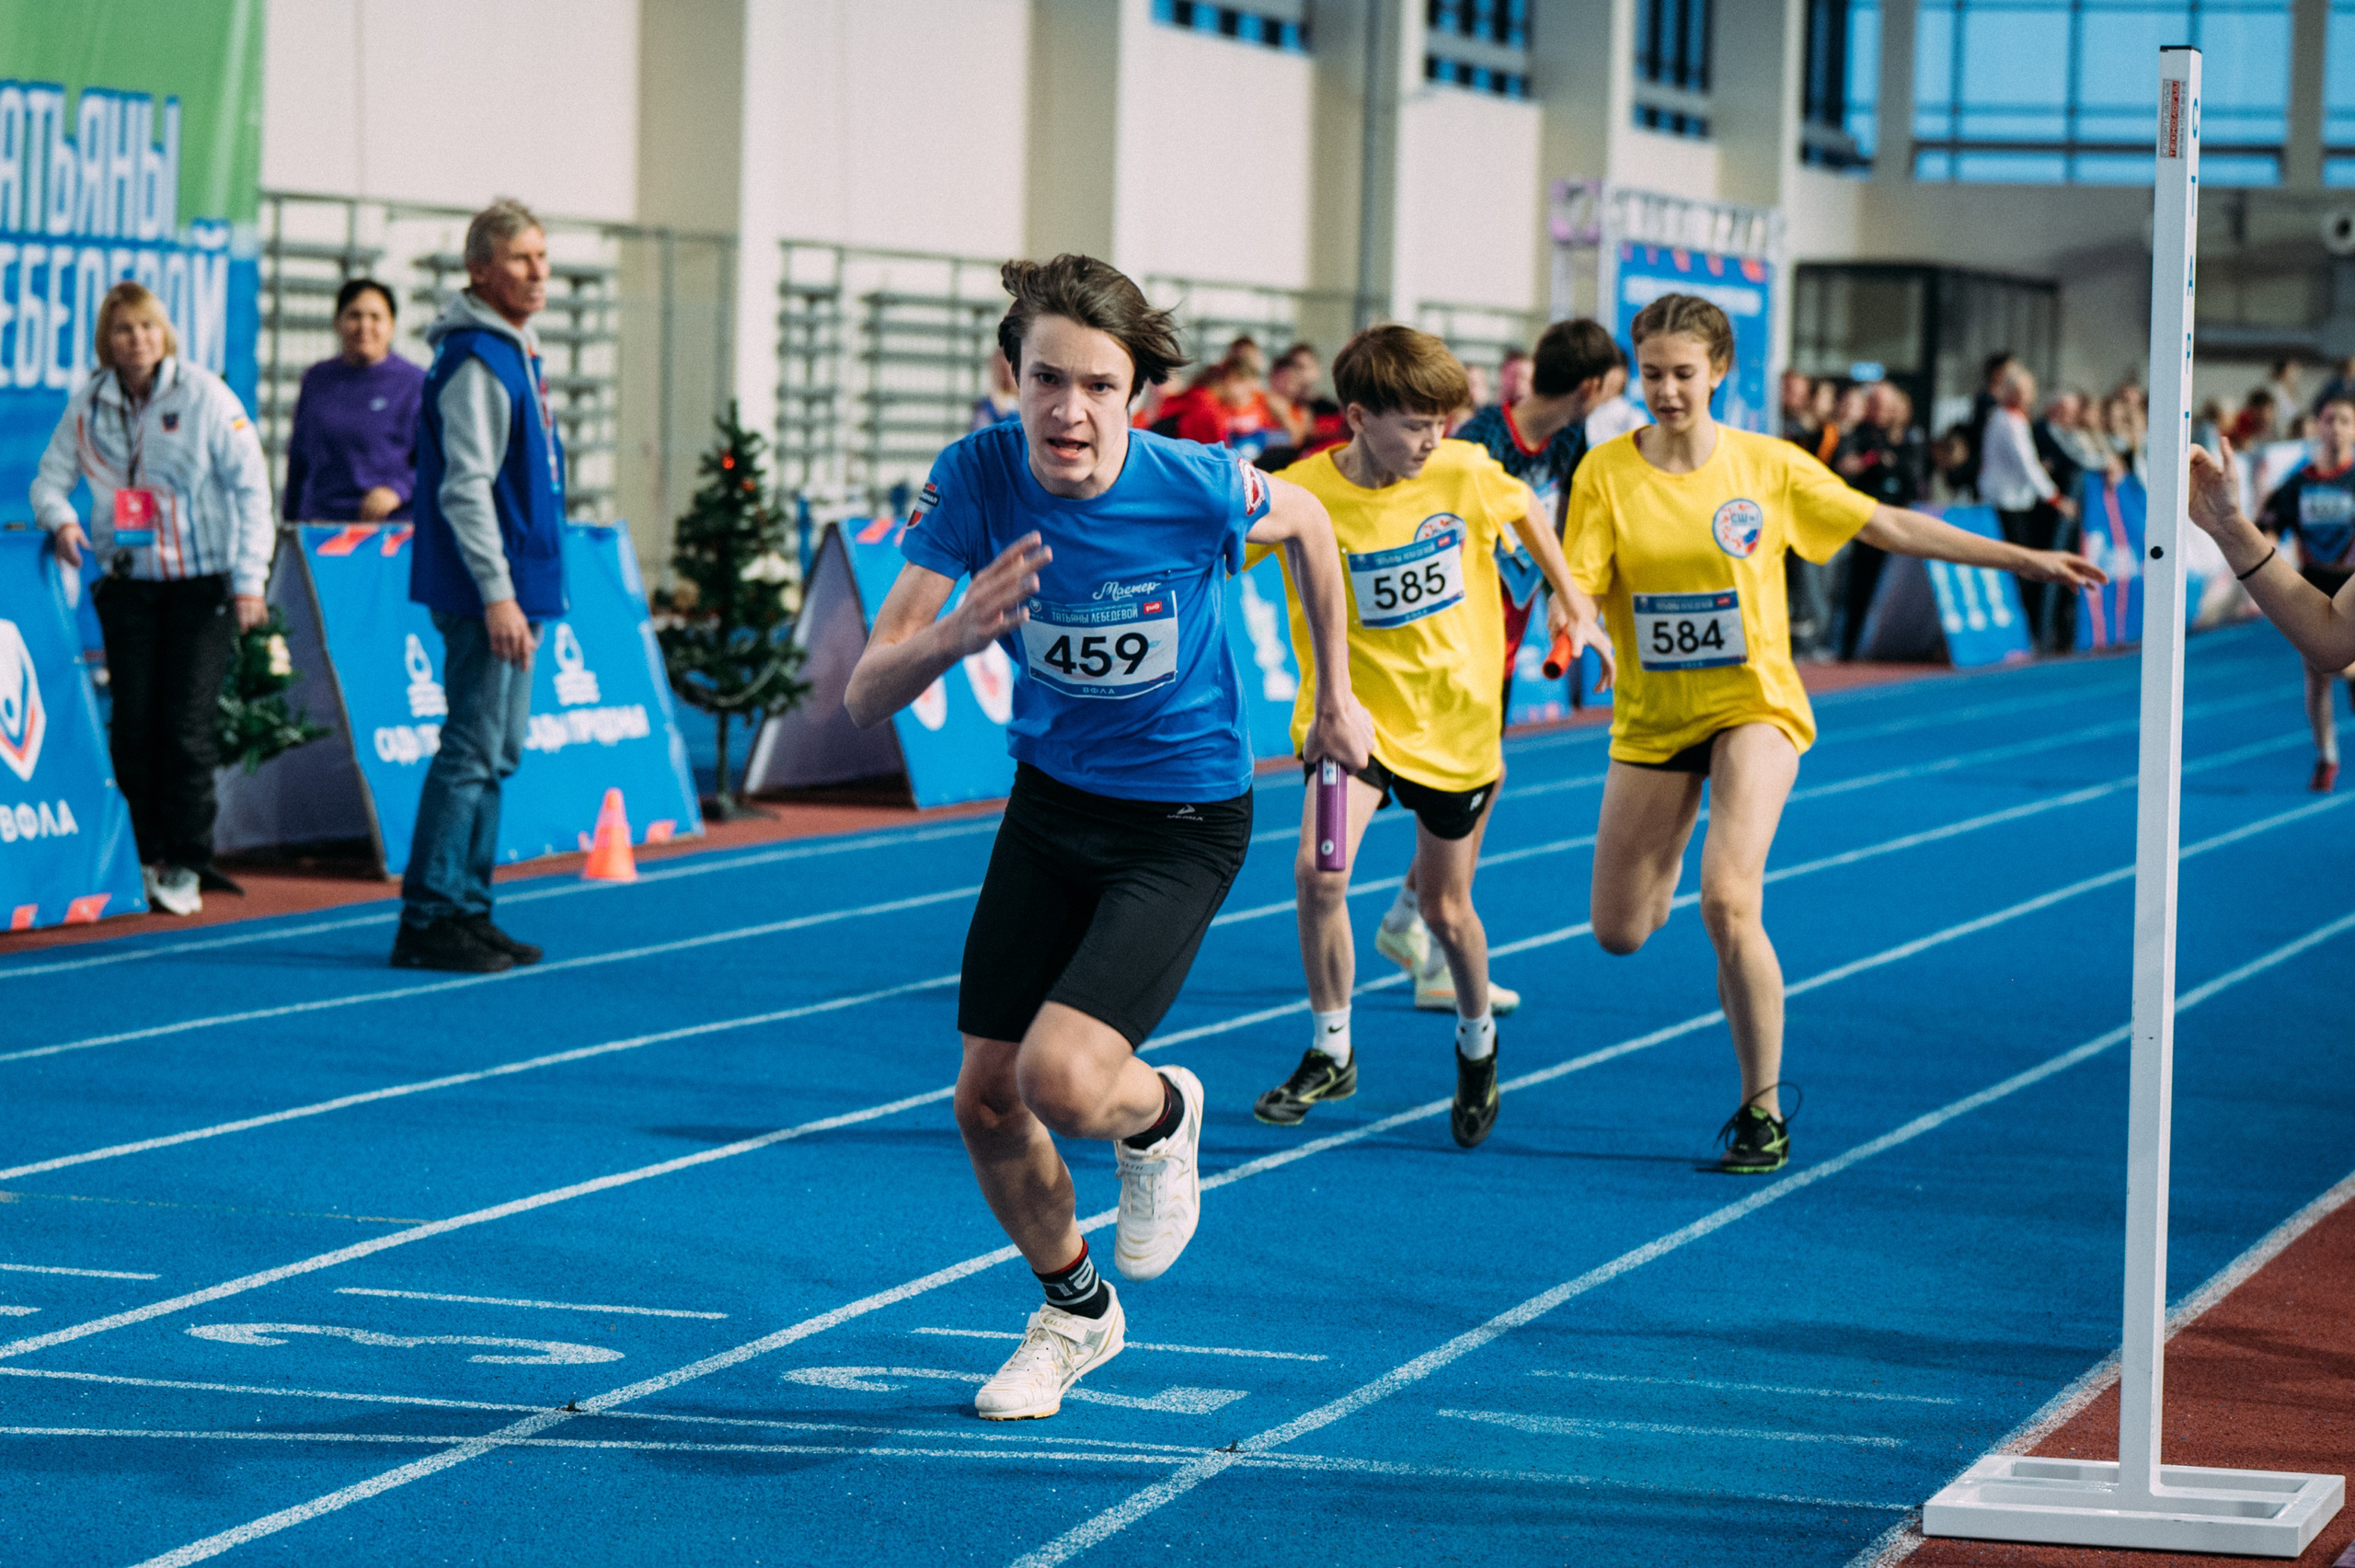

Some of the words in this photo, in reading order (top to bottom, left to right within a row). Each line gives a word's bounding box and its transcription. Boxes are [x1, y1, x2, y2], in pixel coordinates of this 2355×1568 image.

[1092, 580, 1162, 601] Мастер
[1373, 561, 1446, 610] 585
[1051, 612, 1089, 624] ТАТЬЯНЫ
[1090, 607, 1139, 624] ЛЕБЕДЕВОЙ
[1652, 618, 1725, 655] 584
[1044, 632, 1149, 678] 459
[1083, 686, 1115, 694] ВФЛА
